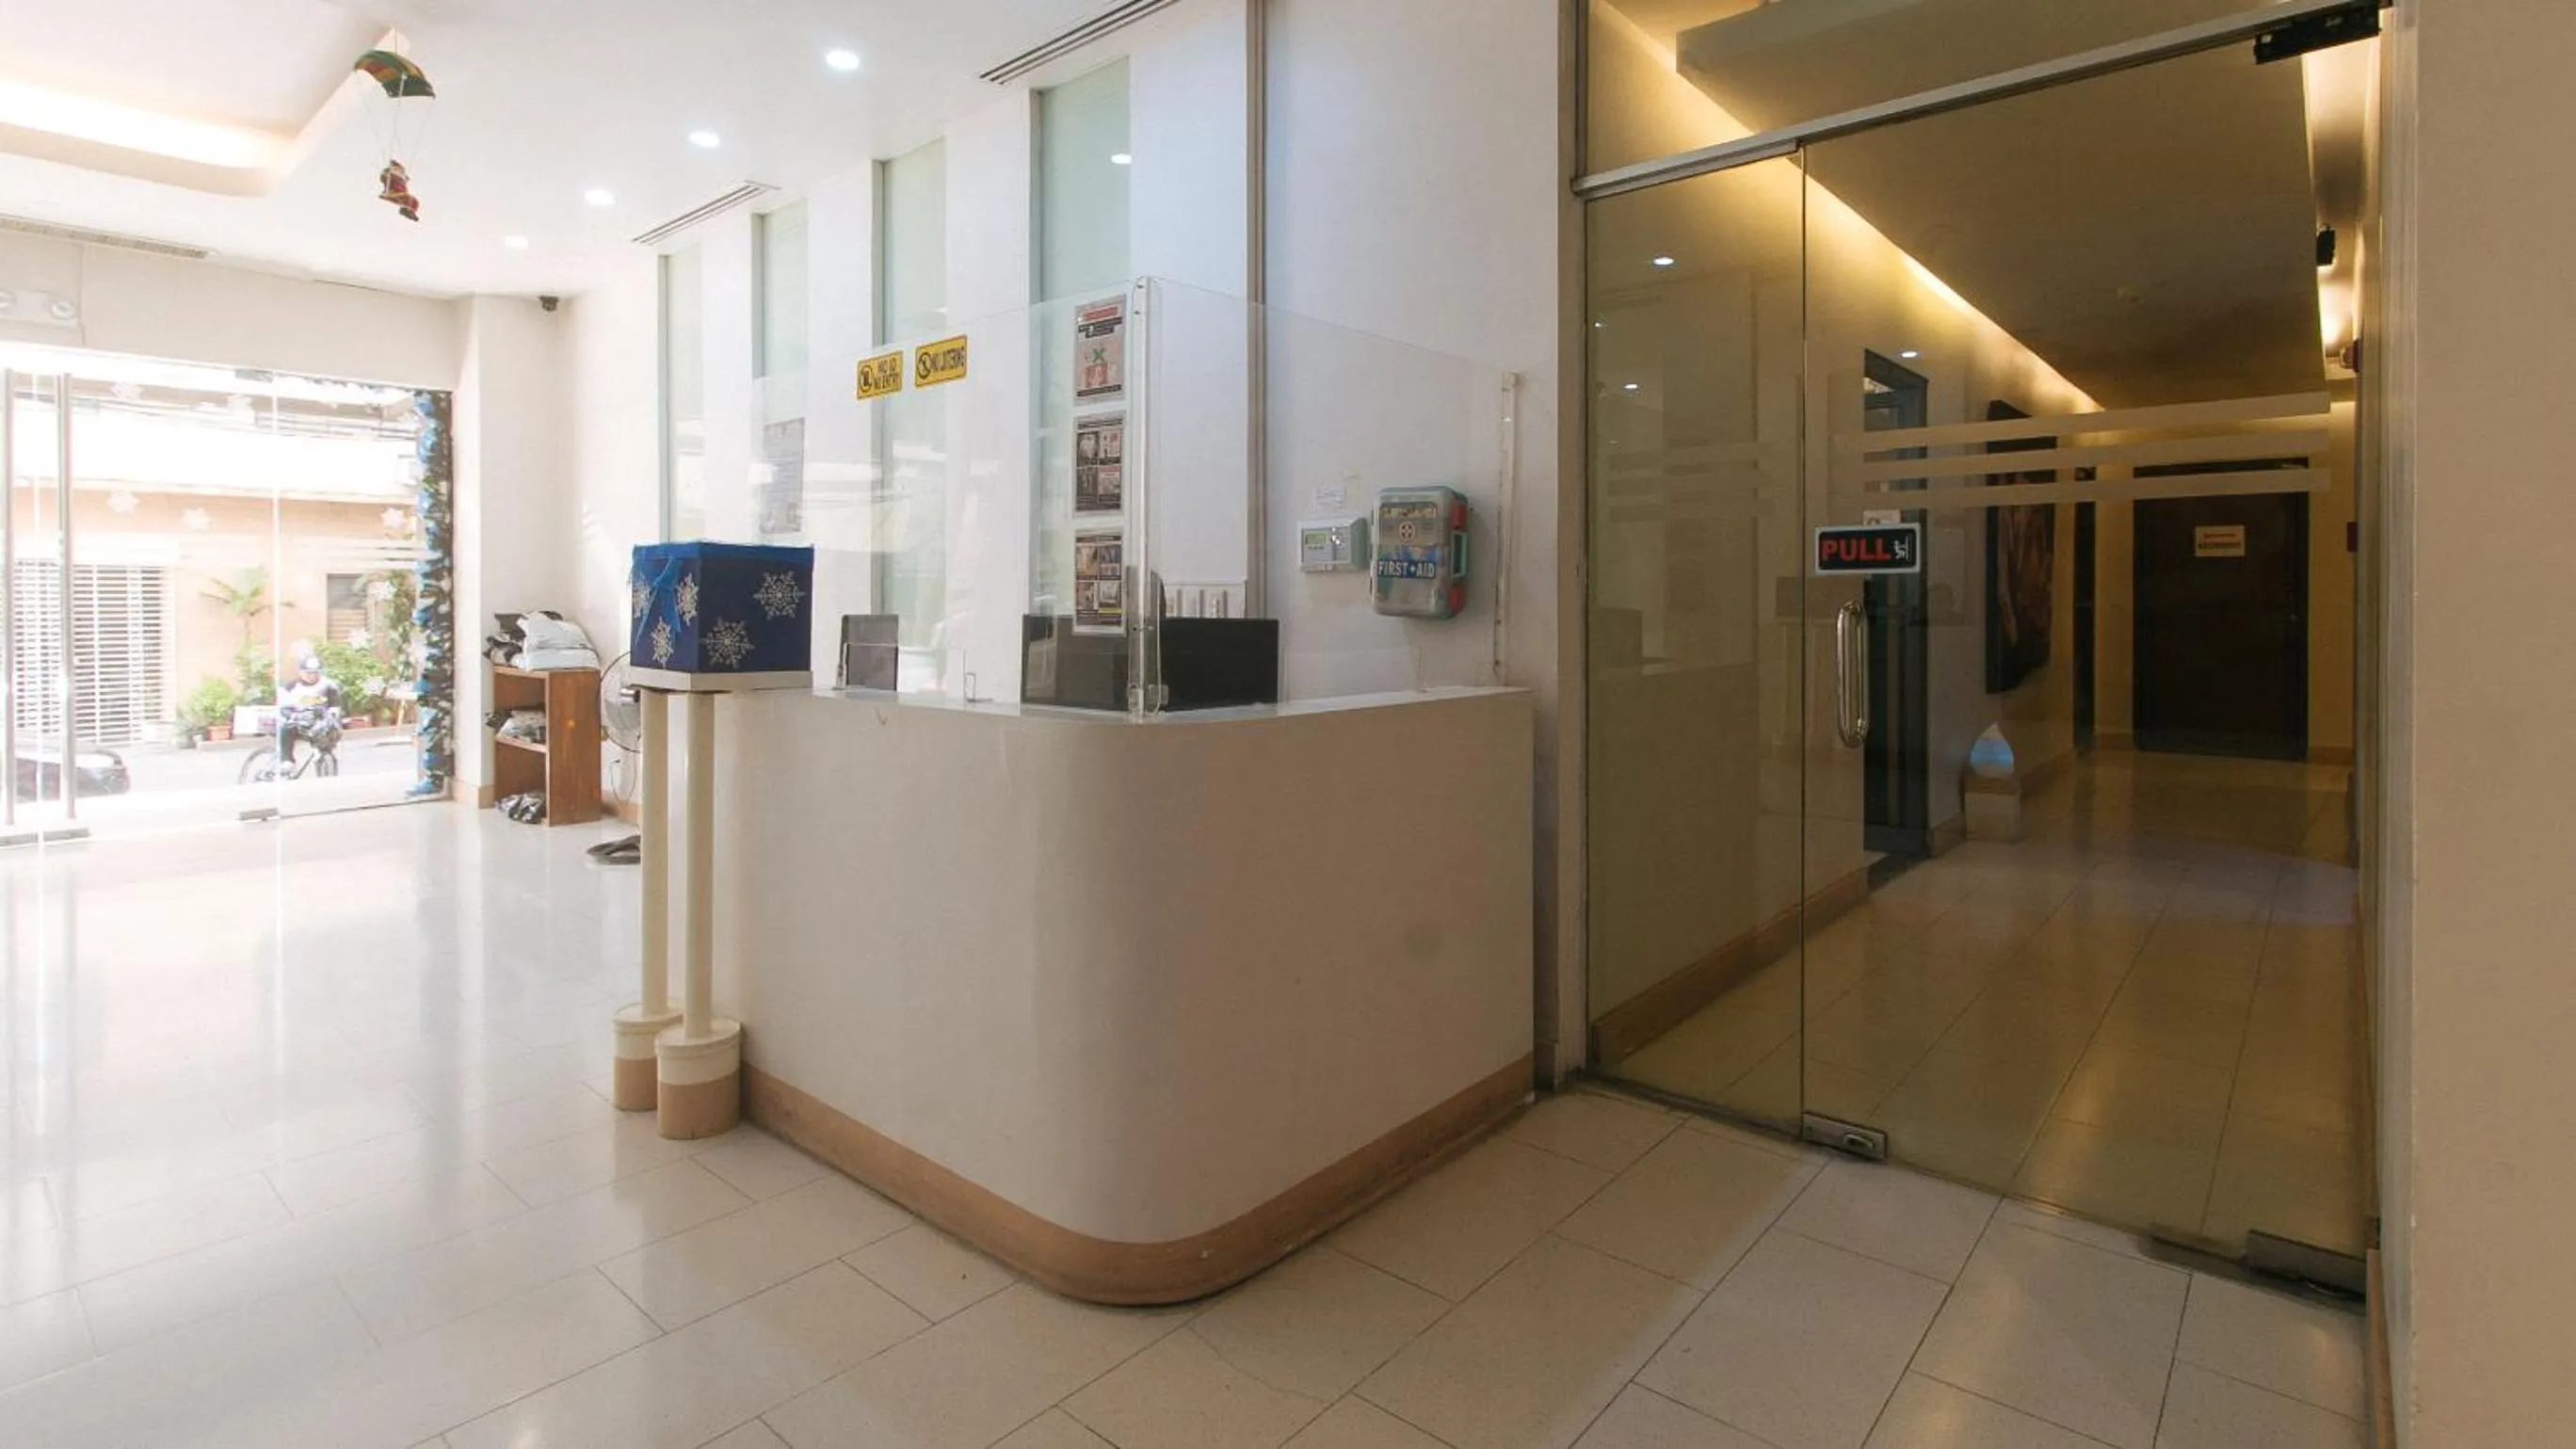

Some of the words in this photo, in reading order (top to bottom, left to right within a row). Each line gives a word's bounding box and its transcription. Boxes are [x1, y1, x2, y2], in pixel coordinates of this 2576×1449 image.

[1822, 538, 1892, 561] PULL
[1378, 560, 1409, 577] FIRST
[1416, 562, 1435, 578] AID
